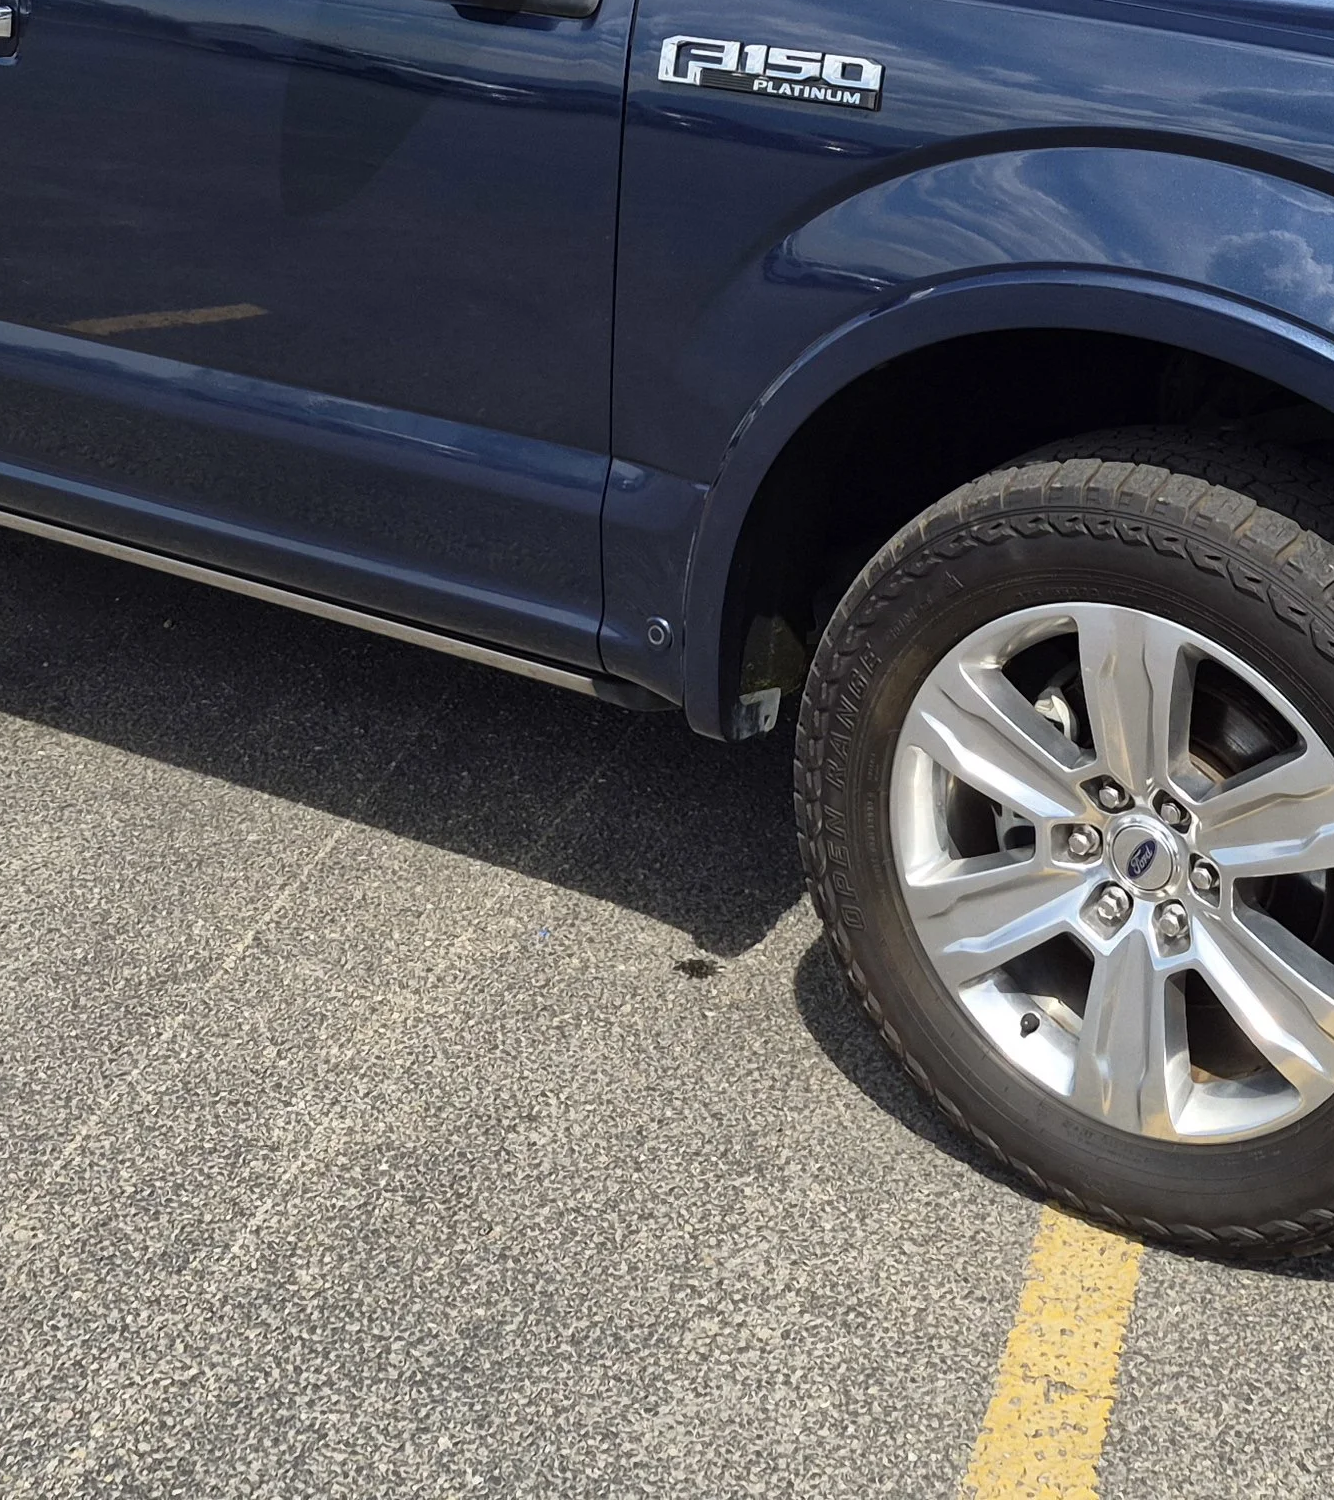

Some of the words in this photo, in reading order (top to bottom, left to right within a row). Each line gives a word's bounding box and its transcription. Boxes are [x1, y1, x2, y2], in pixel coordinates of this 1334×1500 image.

[753, 78, 860, 105] PLATINUM
[825, 643, 882, 792] RANGE
[824, 804, 867, 931] OPEN
